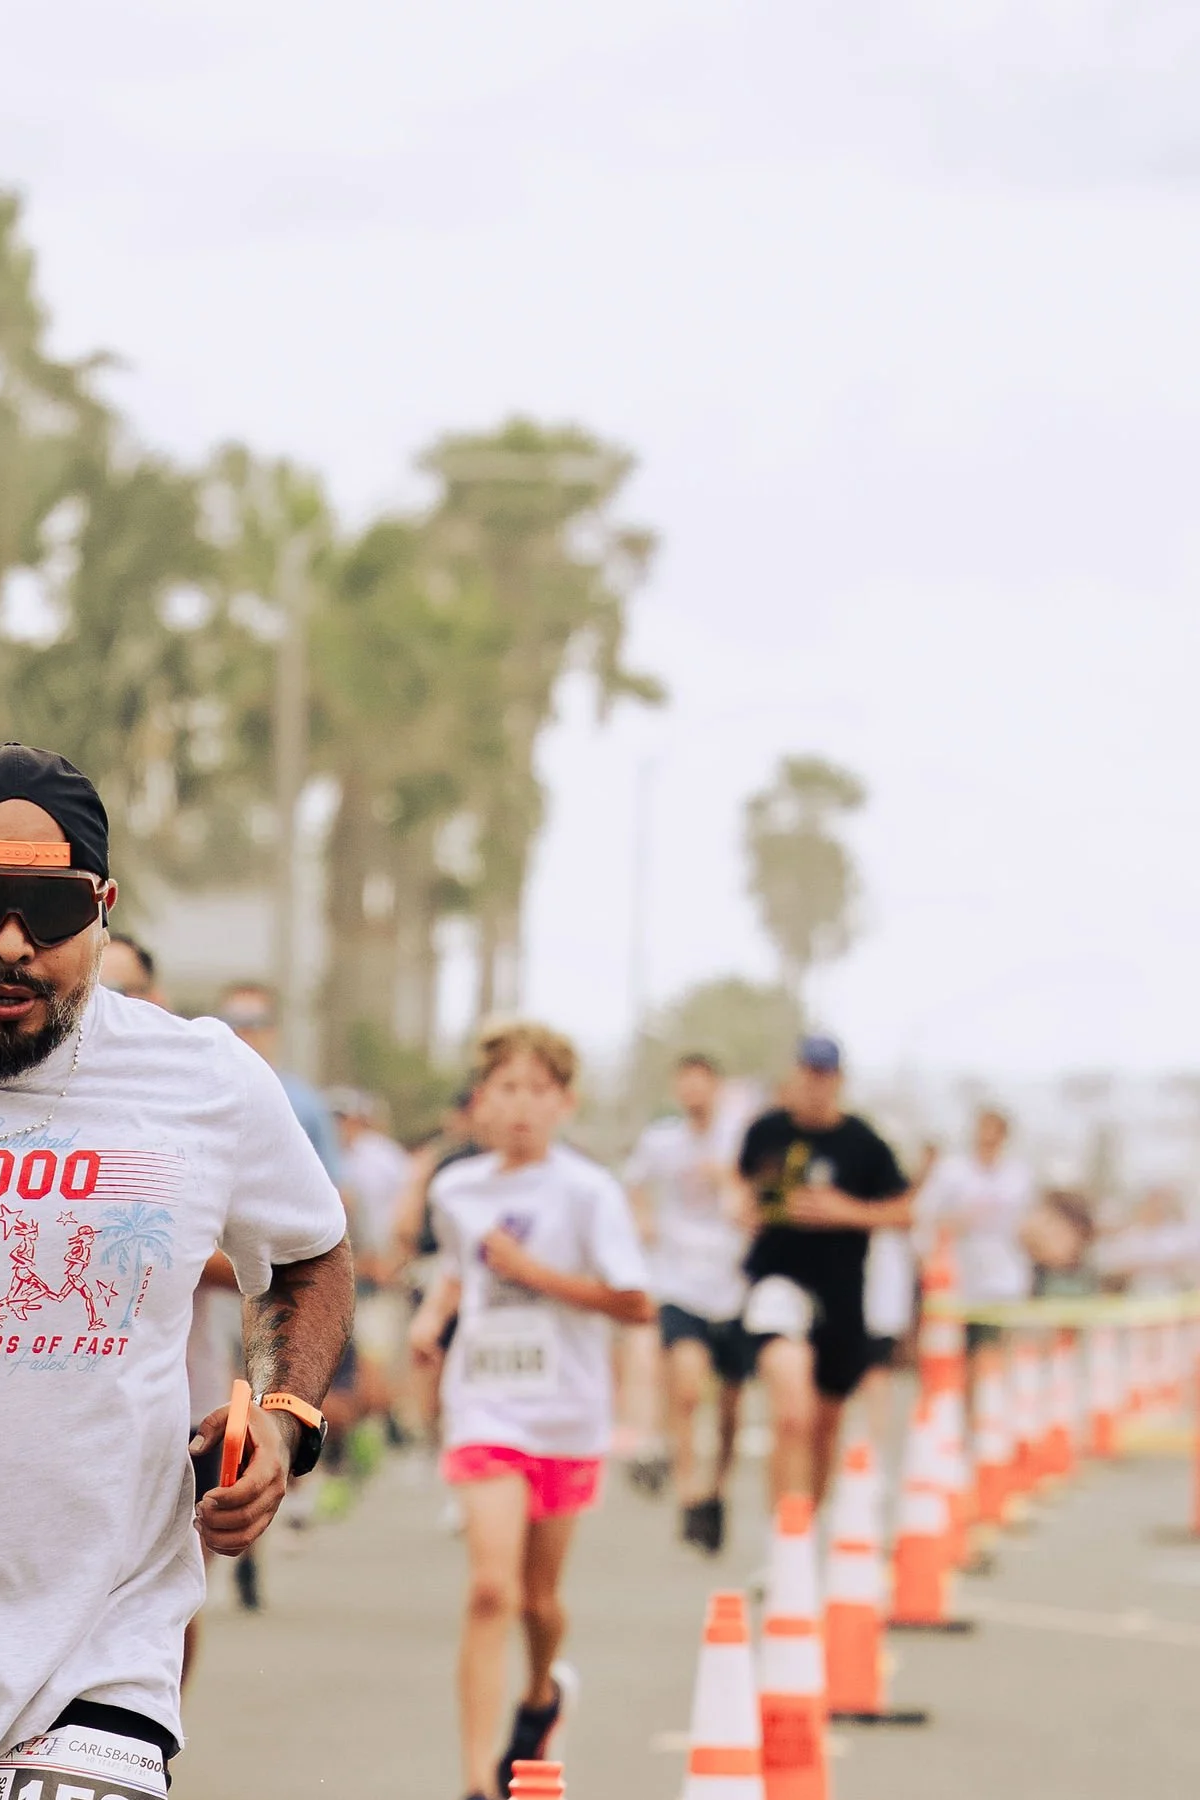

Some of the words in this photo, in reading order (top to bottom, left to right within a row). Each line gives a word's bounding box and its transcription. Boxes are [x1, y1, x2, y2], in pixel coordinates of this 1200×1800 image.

[134, 1266, 153, 1317] 2026
[32, 1334, 62, 1354] OF
[73, 1335, 129, 1356] FAST
